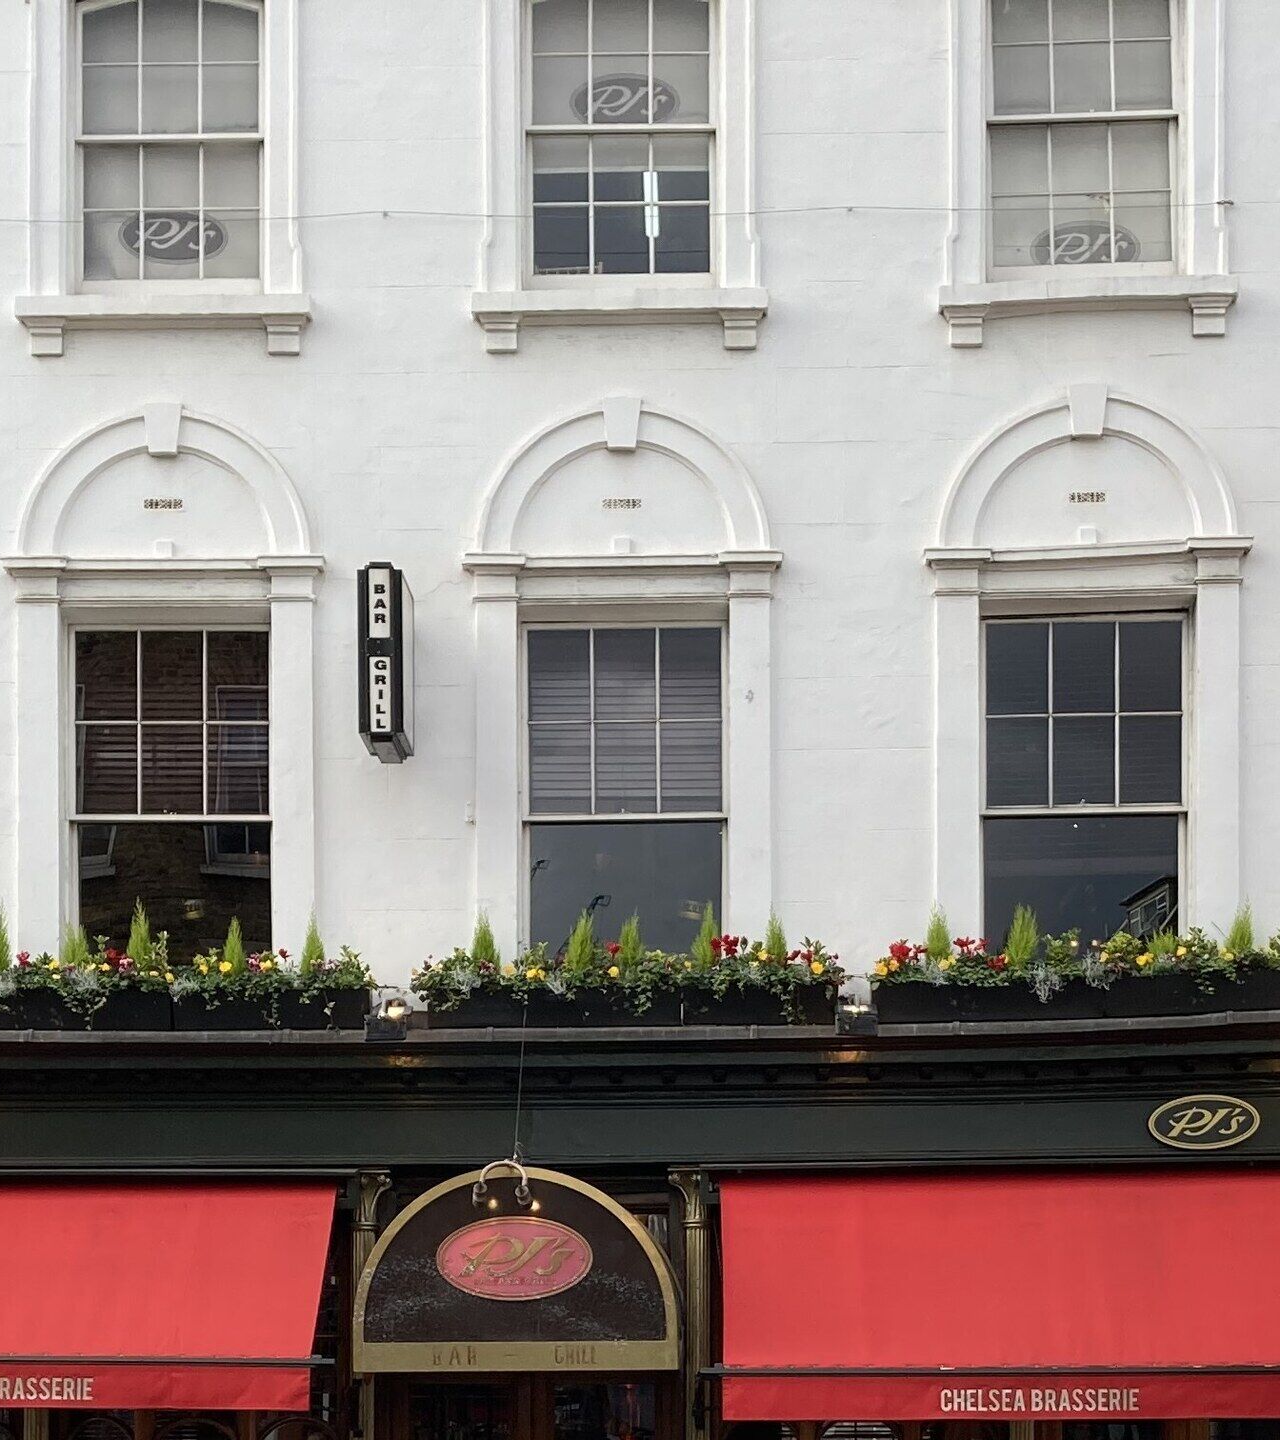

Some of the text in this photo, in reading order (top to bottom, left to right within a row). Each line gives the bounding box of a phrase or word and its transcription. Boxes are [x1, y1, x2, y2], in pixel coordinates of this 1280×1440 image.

[373, 584, 387, 624] BAR
[373, 660, 387, 729] GRILL
[1167, 1106, 1247, 1138] PJ's
[458, 1231, 576, 1278] PJ's
[940, 1388, 1140, 1412] CHELSEA BRASSERIE
